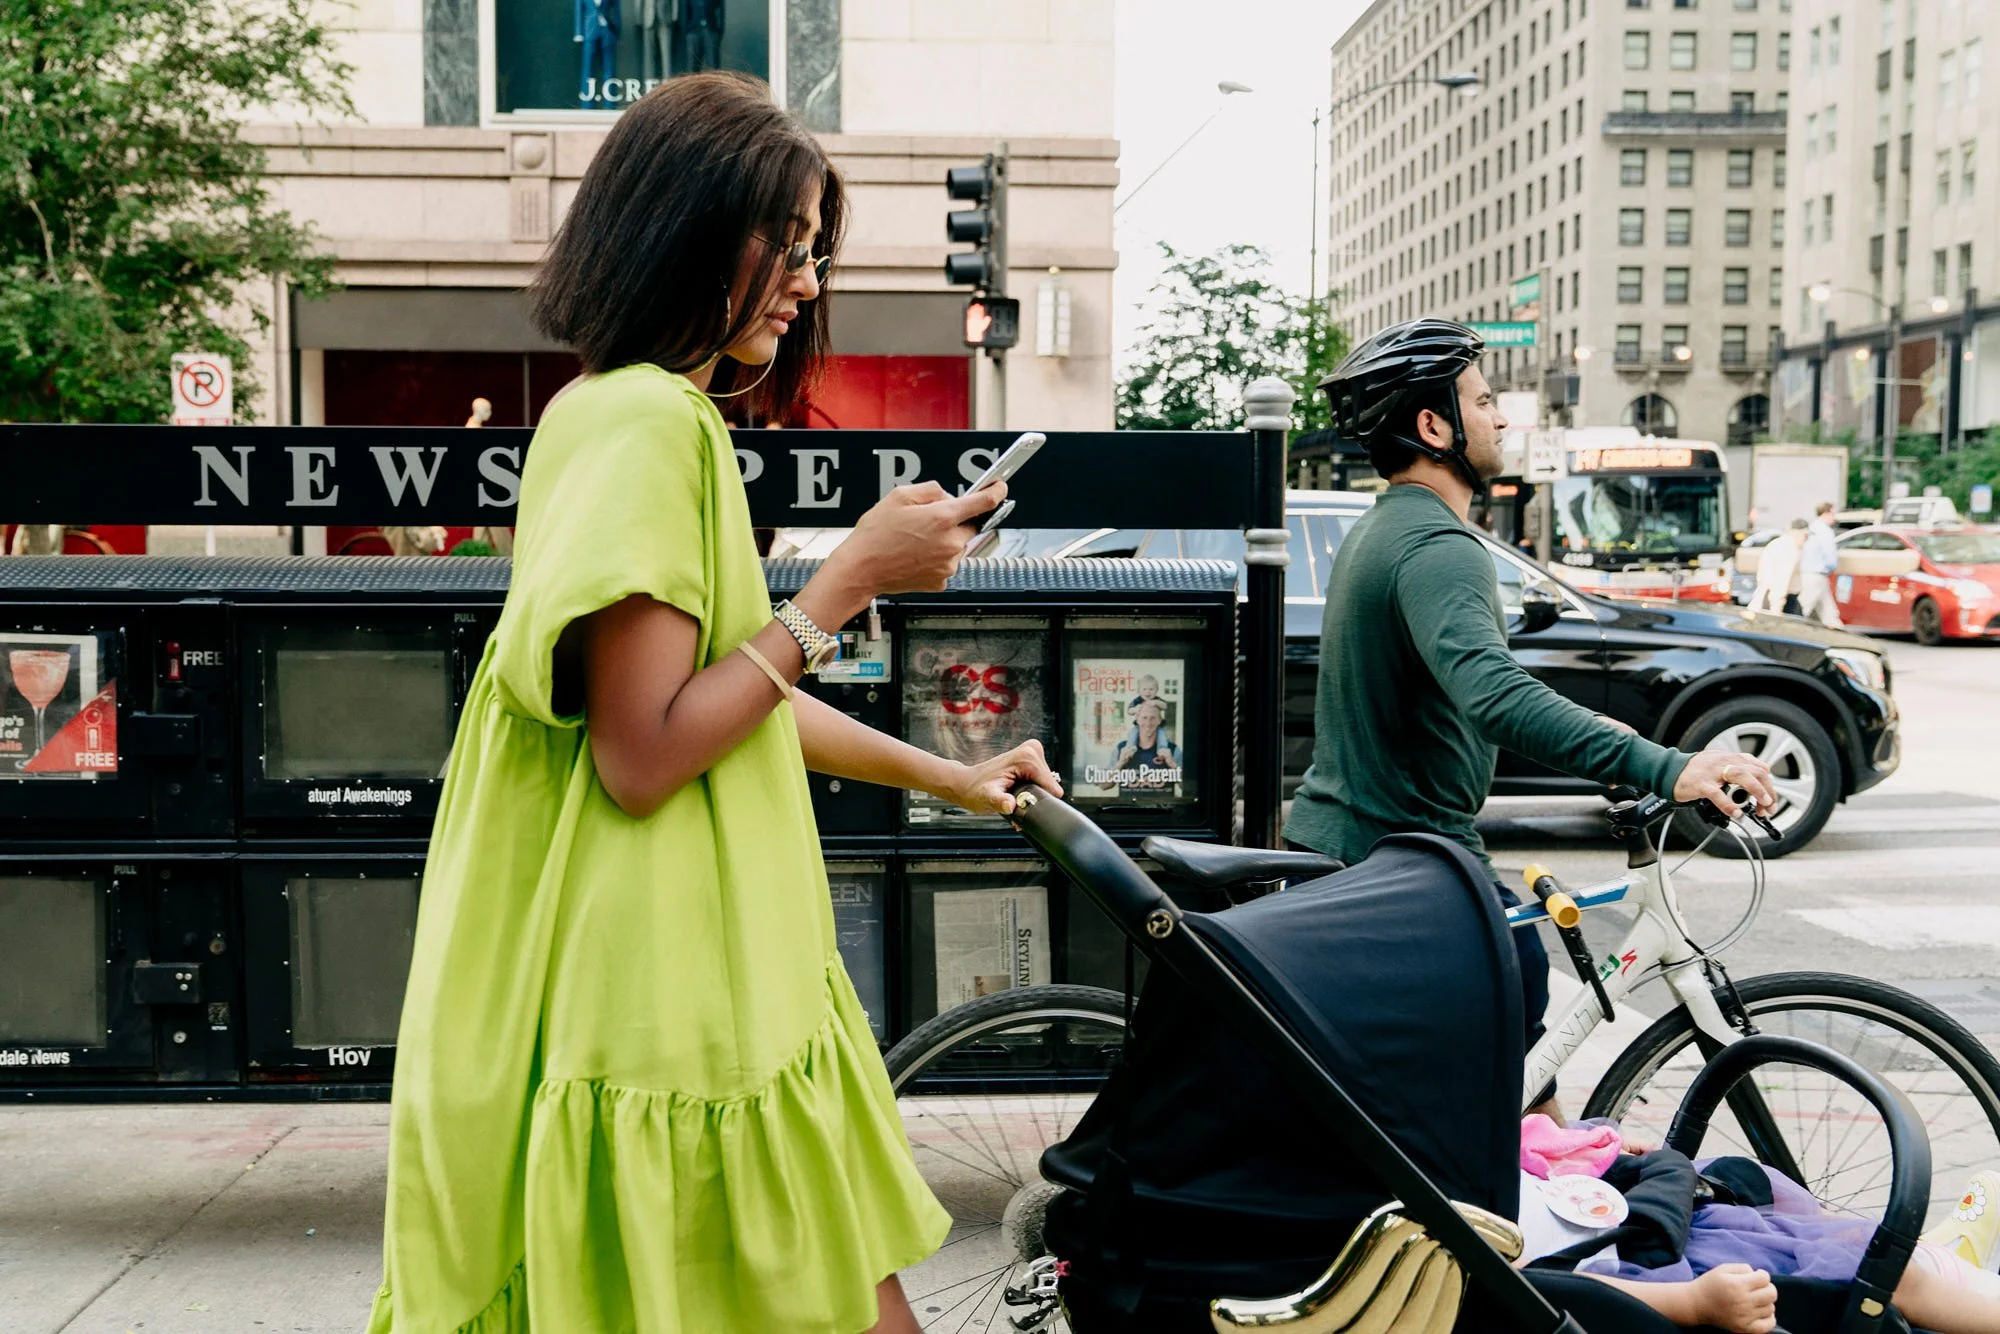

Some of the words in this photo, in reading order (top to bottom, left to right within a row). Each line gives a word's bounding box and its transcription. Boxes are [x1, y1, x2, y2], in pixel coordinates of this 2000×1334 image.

[578, 78, 663, 102] J.CRE
[454, 613, 476, 623] PULL
[182, 651, 224, 666] FREE
[855, 651, 872, 659] AILY
[1078, 667, 1135, 693] Parent
[941, 664, 1020, 715] CS
[75, 752, 115, 767] FREE
[1085, 764, 1136, 787] Chicago
[1139, 763, 1183, 782] Parent
[343, 787, 412, 806] Awakenings
[113, 865, 137, 875] PULL
[0, 1050, 29, 1066] dale
[31, 1049, 70, 1065] News
